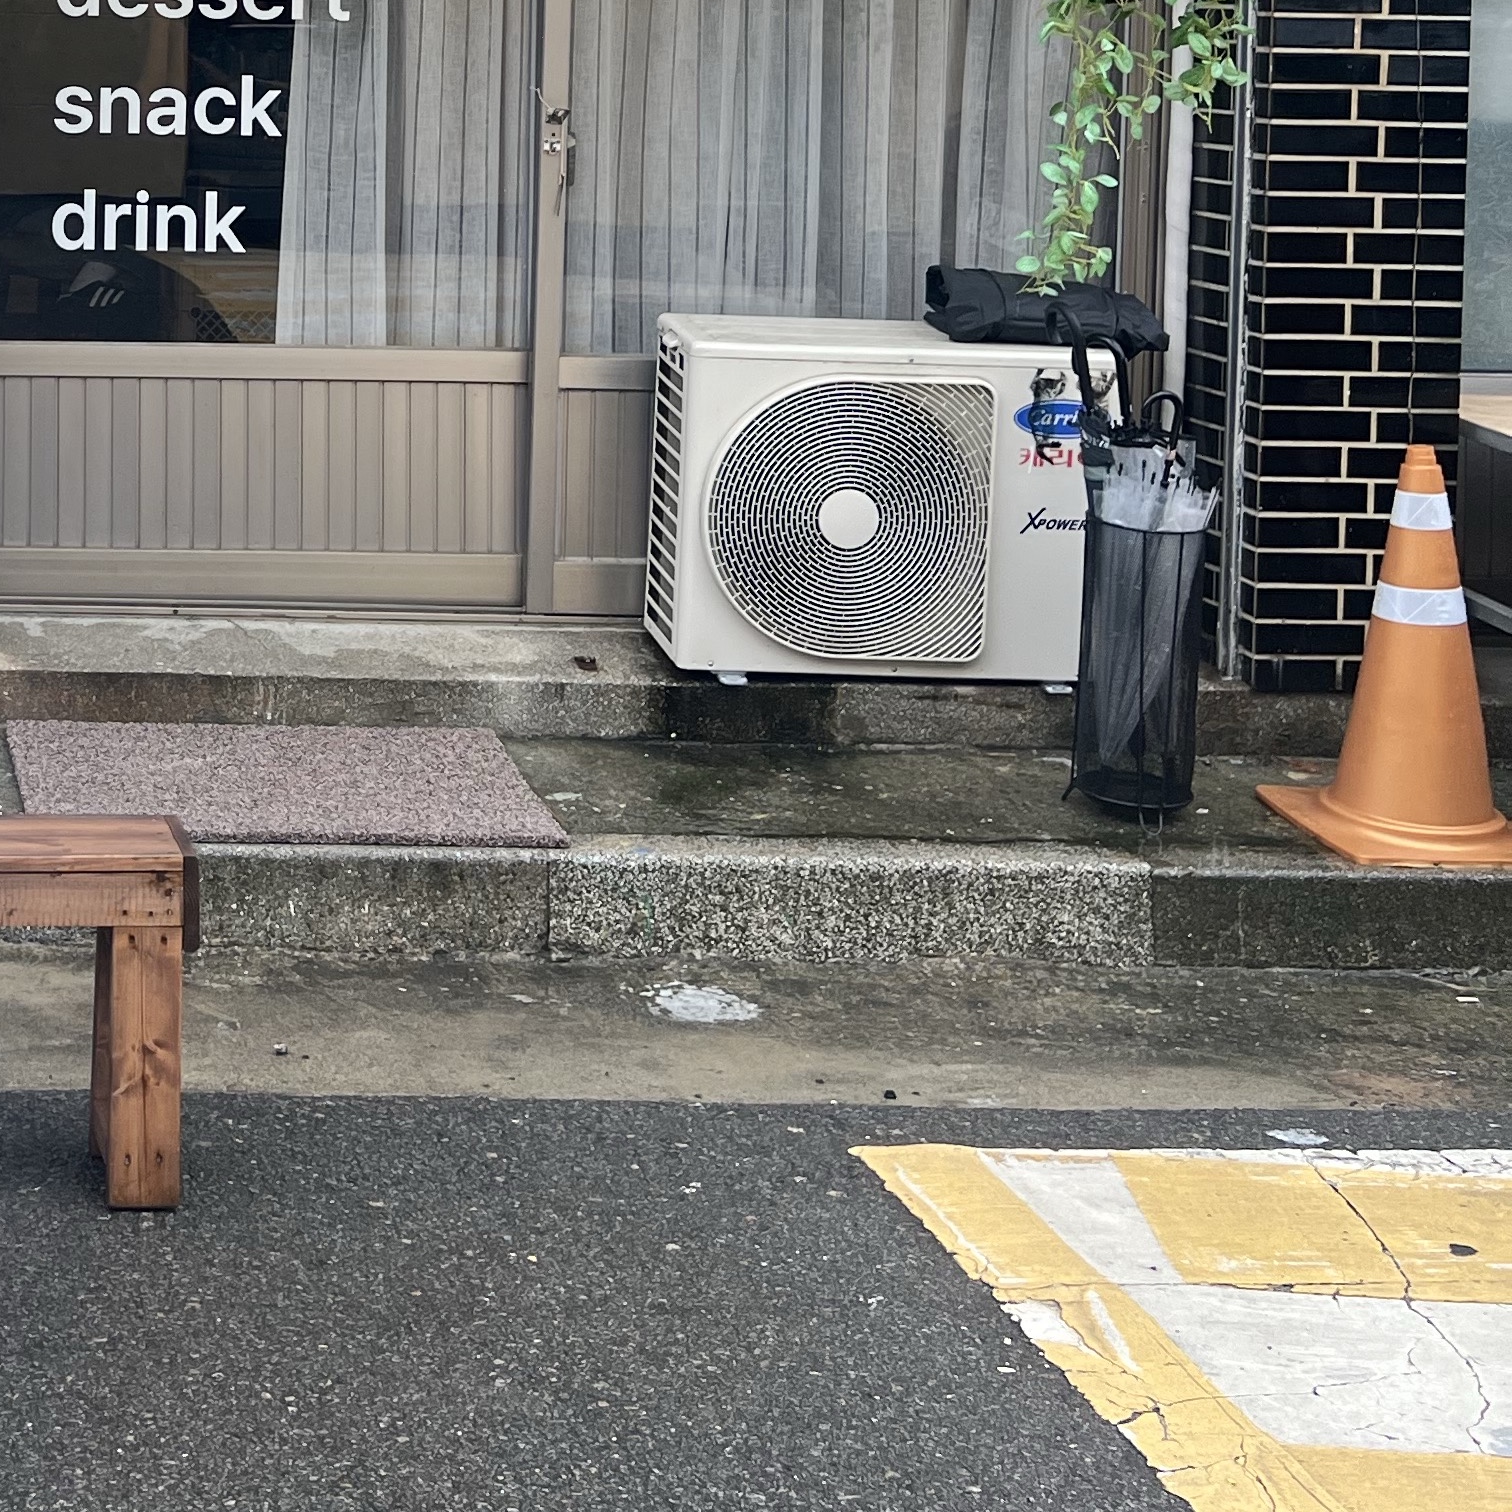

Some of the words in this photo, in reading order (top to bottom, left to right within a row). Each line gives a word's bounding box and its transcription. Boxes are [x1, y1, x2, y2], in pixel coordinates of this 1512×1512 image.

[53, 74, 282, 137] snack
[52, 188, 247, 253] drink
[1018, 447, 1085, 468] 캐리
